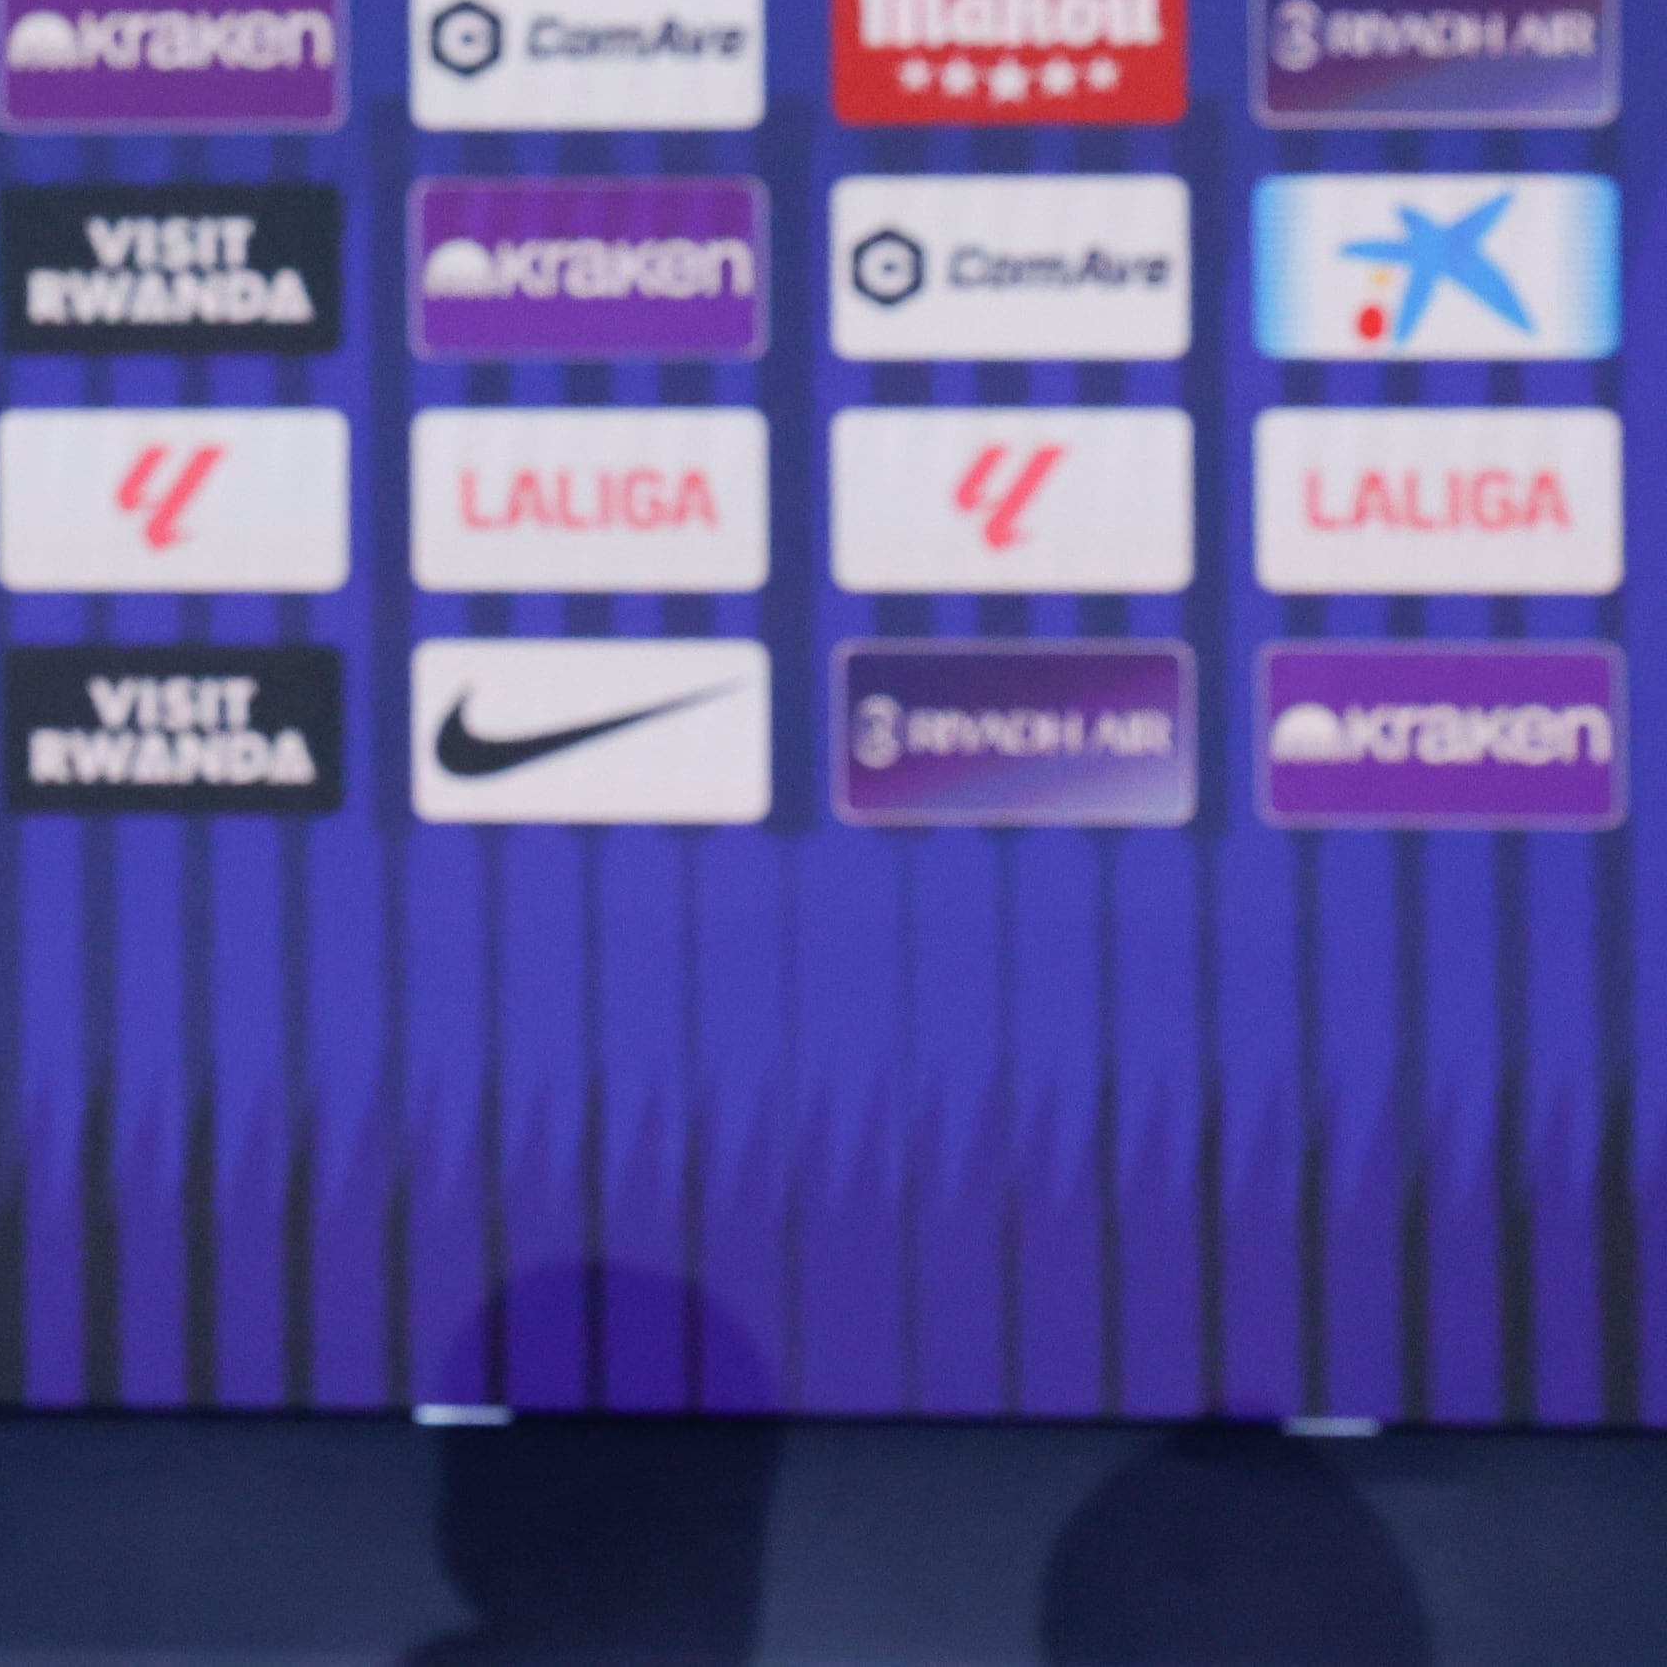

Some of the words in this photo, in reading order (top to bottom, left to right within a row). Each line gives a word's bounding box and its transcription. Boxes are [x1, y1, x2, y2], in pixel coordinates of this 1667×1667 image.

[86, 217, 254, 270] VISIT
[27, 270, 312, 323] RWANDA
[460, 467, 719, 532] LALIGA
[1304, 468, 1571, 533] LALIGA
[88, 677, 256, 729] VISIT
[29, 730, 315, 784] RWANDA
